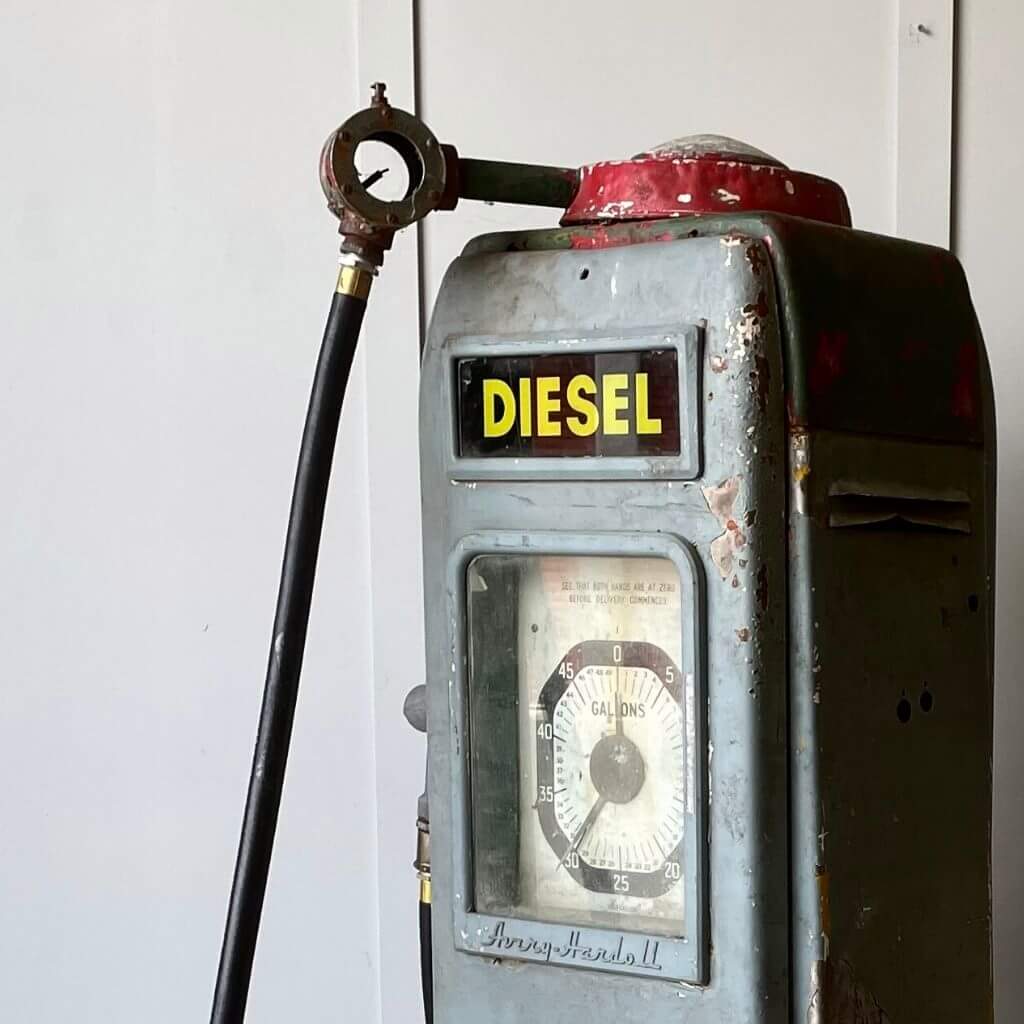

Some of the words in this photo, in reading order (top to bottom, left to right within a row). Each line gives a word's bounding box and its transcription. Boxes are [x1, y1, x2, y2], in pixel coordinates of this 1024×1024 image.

[482, 372, 663, 438] DIESEL
[613, 645, 622, 662] 0
[558, 661, 574, 679] 45
[665, 665, 674, 683] 5
[591, 700, 646, 718] GALONS
[537, 723, 553, 740] 40
[539, 785, 553, 802] 35
[564, 851, 579, 869] 30
[664, 862, 680, 880] 20
[613, 873, 630, 892] 25
